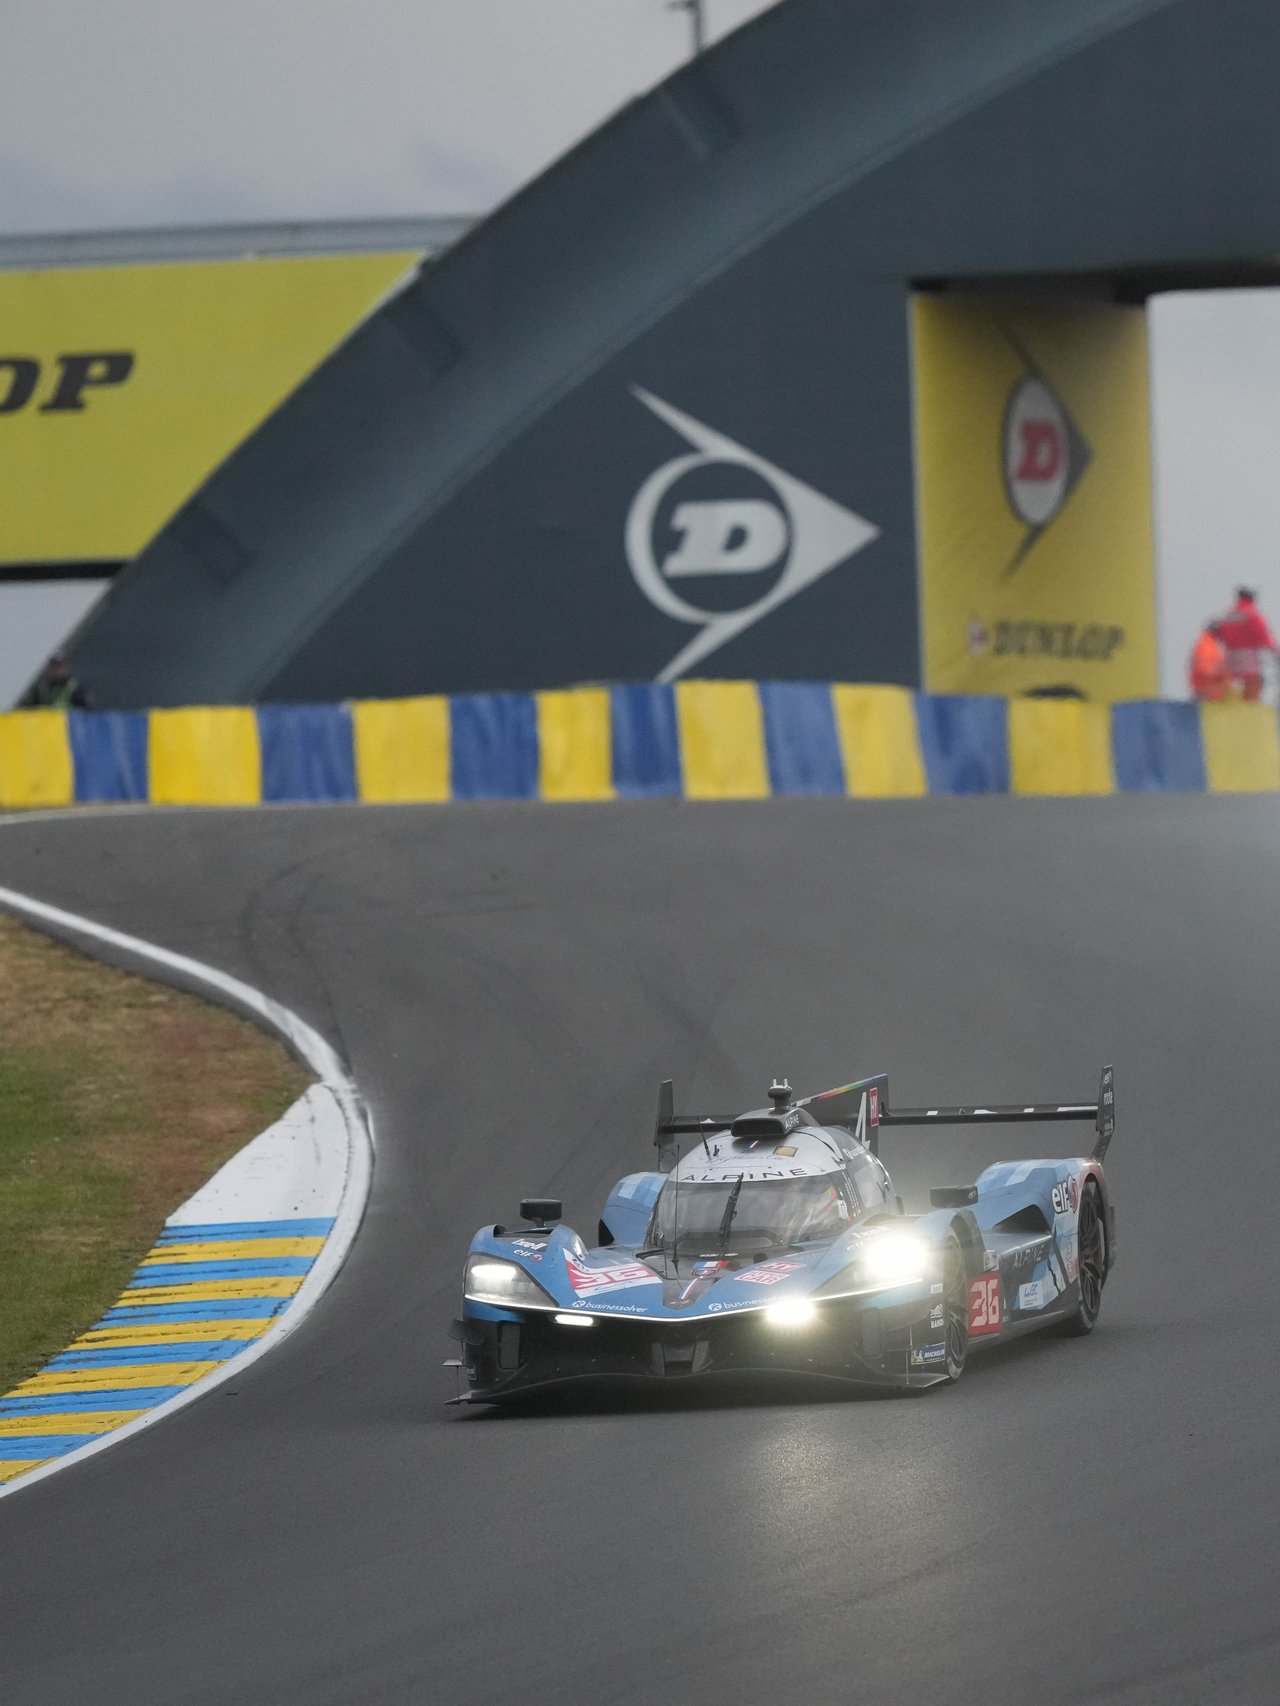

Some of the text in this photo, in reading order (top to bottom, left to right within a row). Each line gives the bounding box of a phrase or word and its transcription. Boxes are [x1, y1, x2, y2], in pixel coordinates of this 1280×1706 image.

[661, 499, 787, 577] D
[994, 620, 1124, 661] DUNLOP
[680, 1167, 808, 1182] ALPINE
[585, 1302, 648, 1313] businessolver
[971, 1278, 1000, 1327] 36
